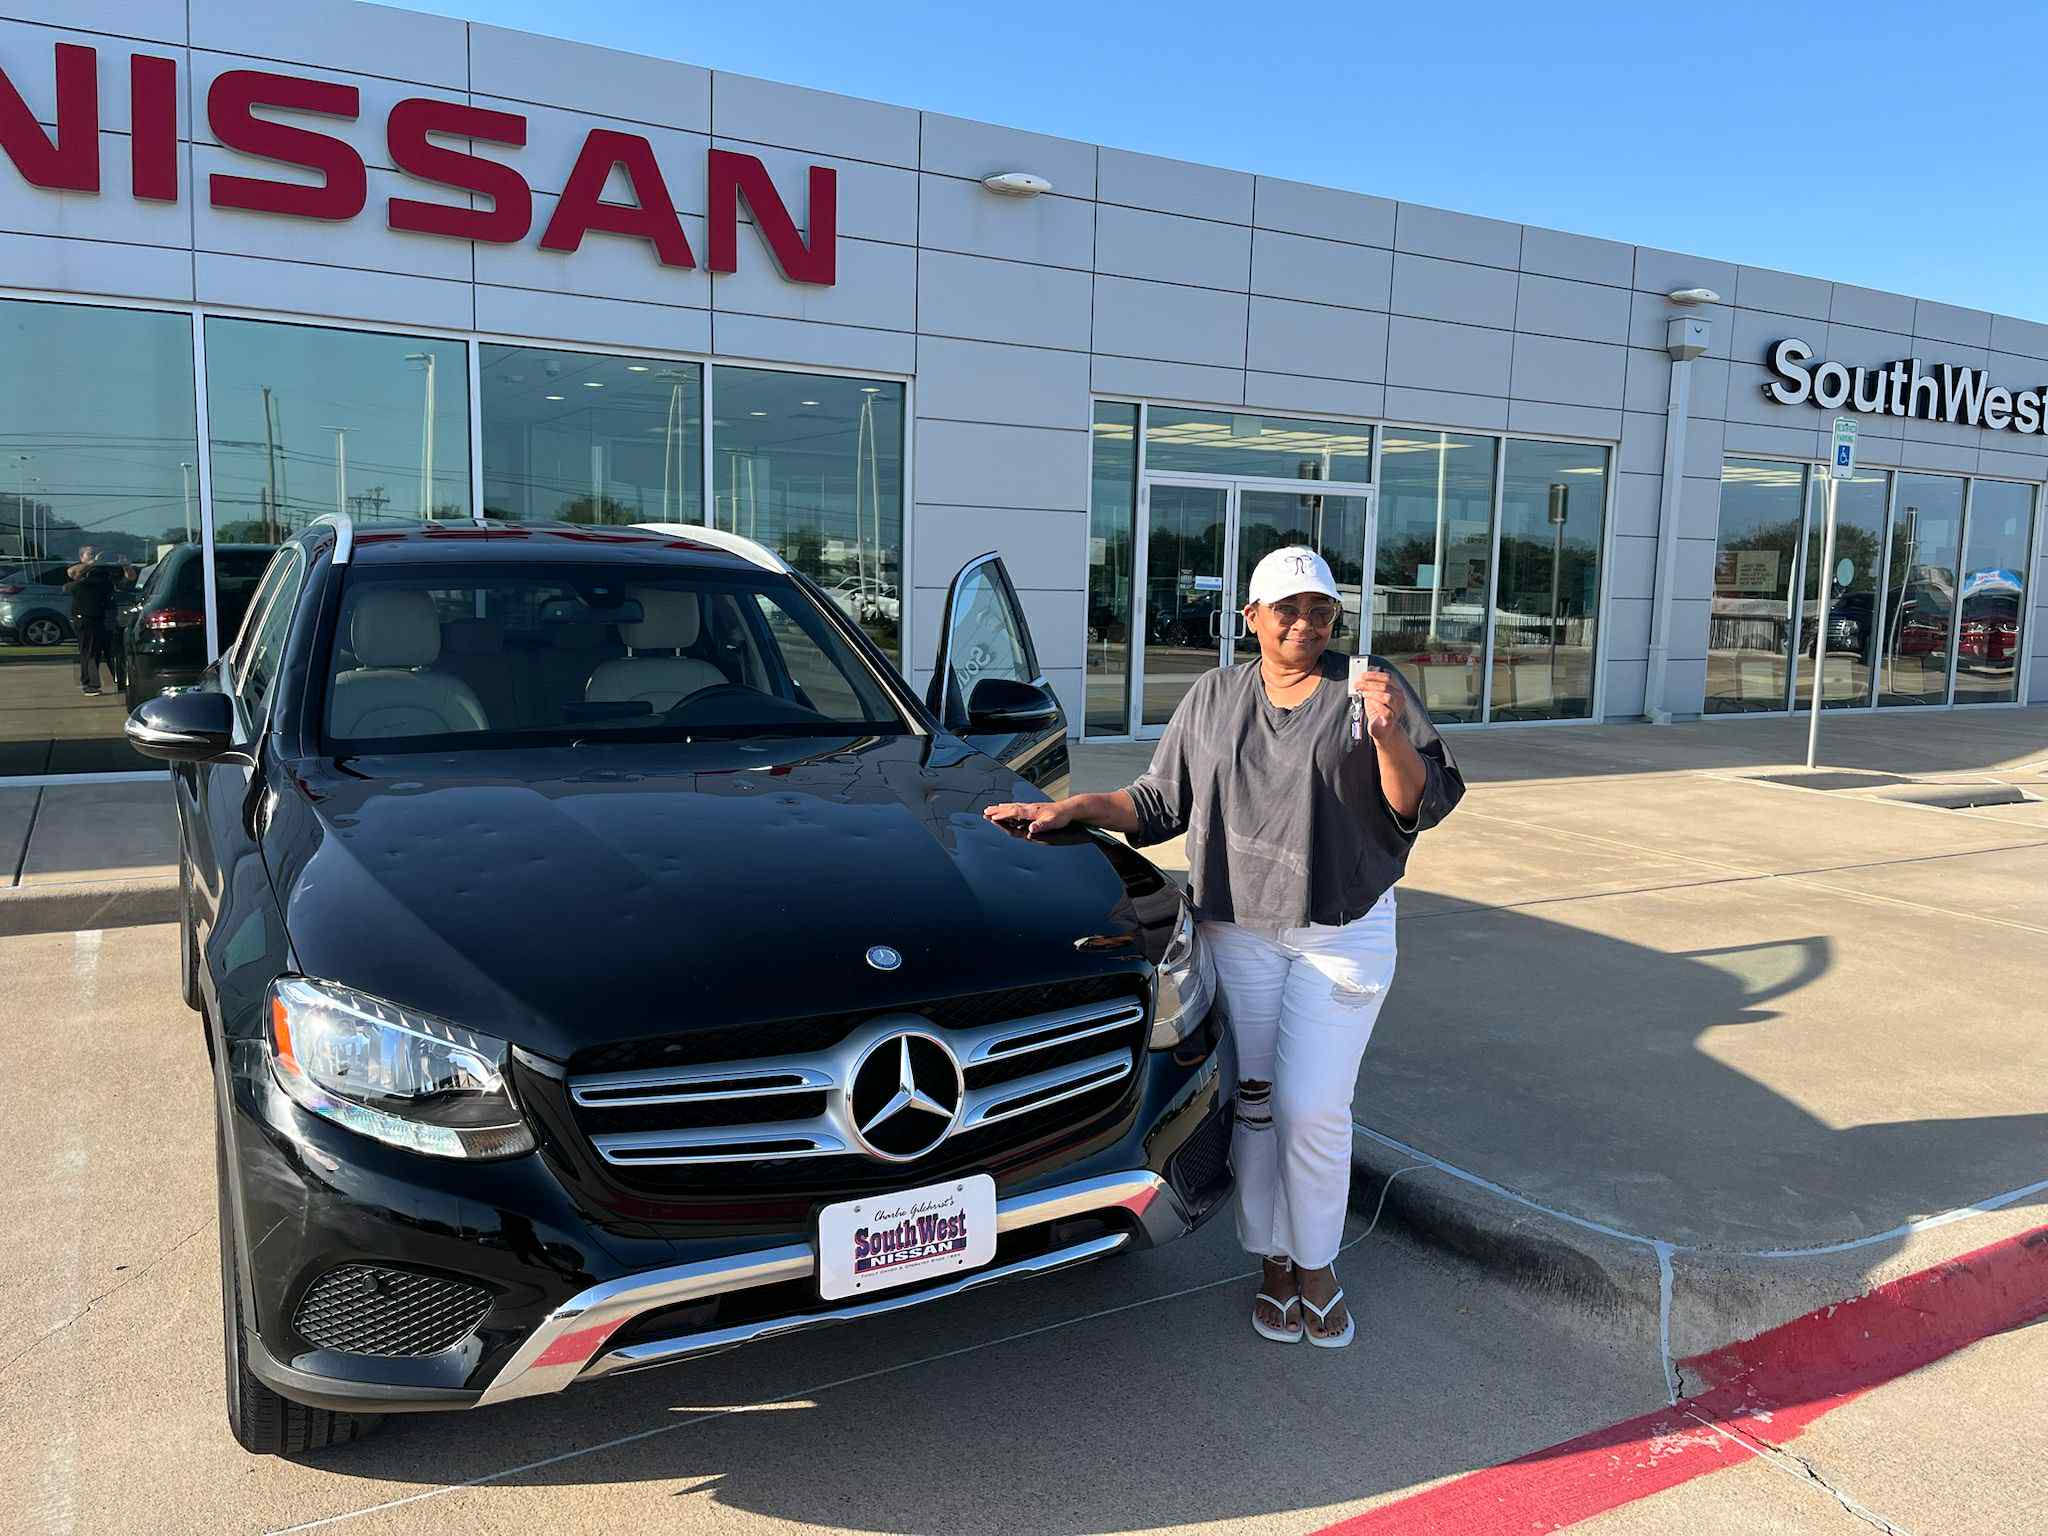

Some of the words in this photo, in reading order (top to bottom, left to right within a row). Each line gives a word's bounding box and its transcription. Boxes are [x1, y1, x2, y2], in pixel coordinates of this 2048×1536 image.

[0, 42, 837, 287] NISSAN
[874, 1207, 907, 1221] Charlie
[854, 1208, 967, 1260] SouthWest
[870, 1241, 953, 1267] NISSAN
